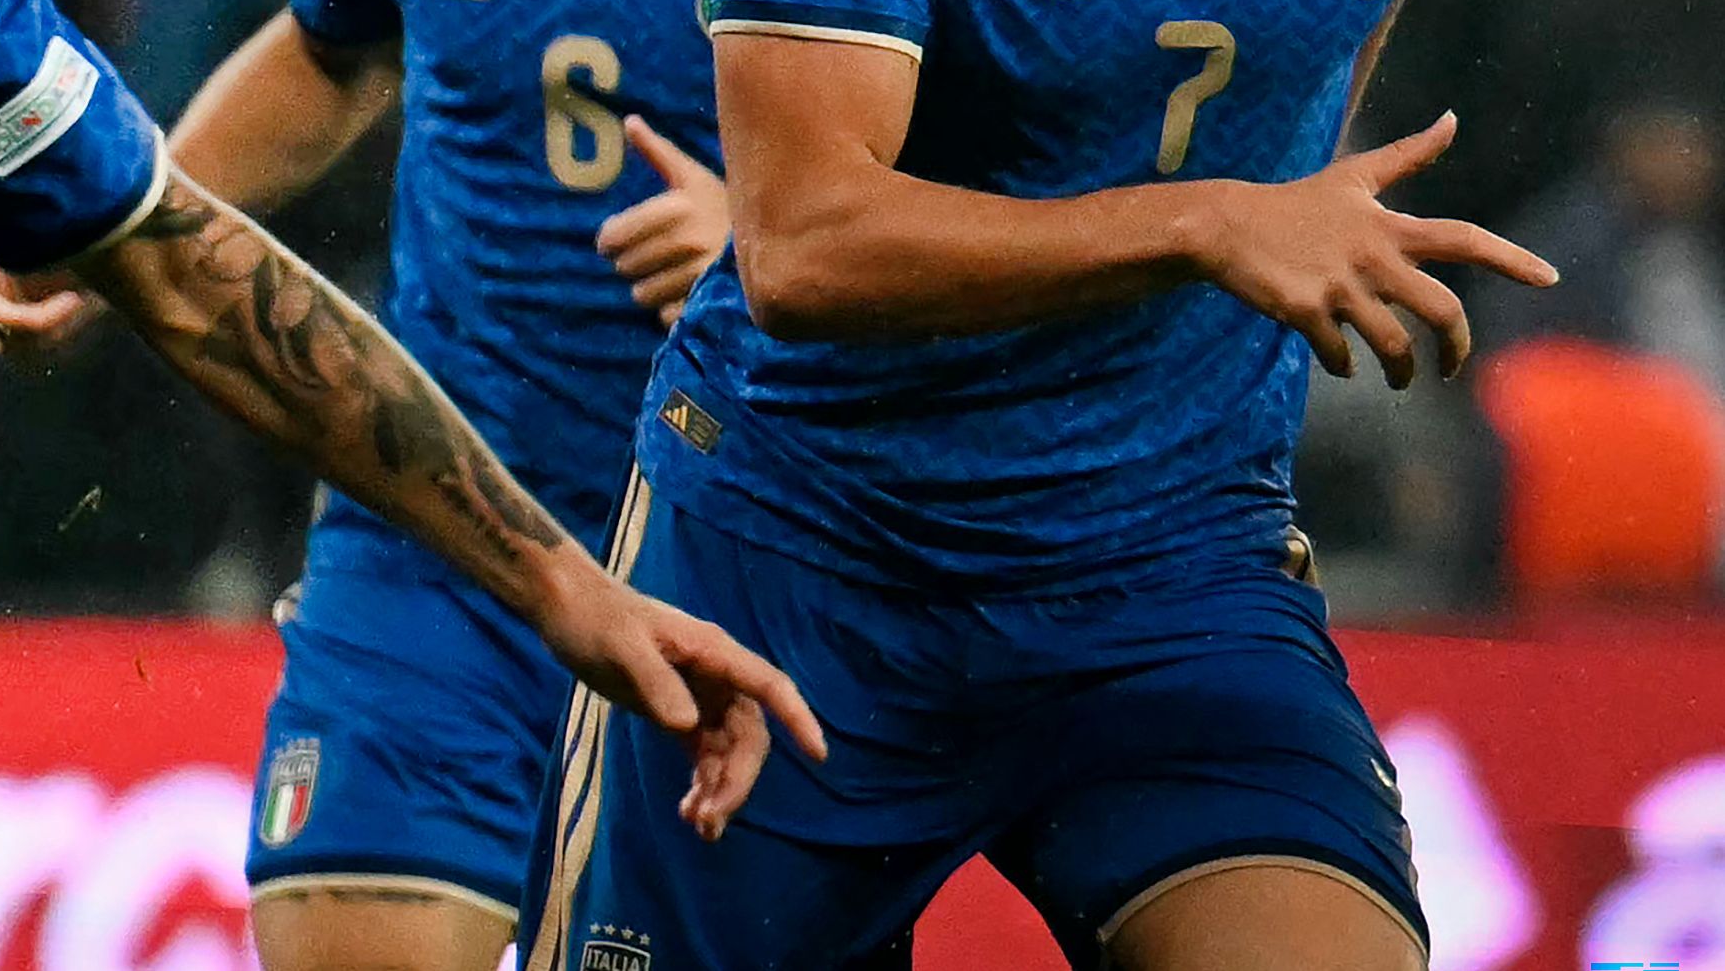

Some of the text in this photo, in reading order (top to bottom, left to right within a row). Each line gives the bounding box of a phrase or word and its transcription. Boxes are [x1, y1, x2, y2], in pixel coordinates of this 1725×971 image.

[540, 34, 627, 192] 6
[1155, 19, 1237, 175] 7
[585, 947, 641, 971] ITALIA
